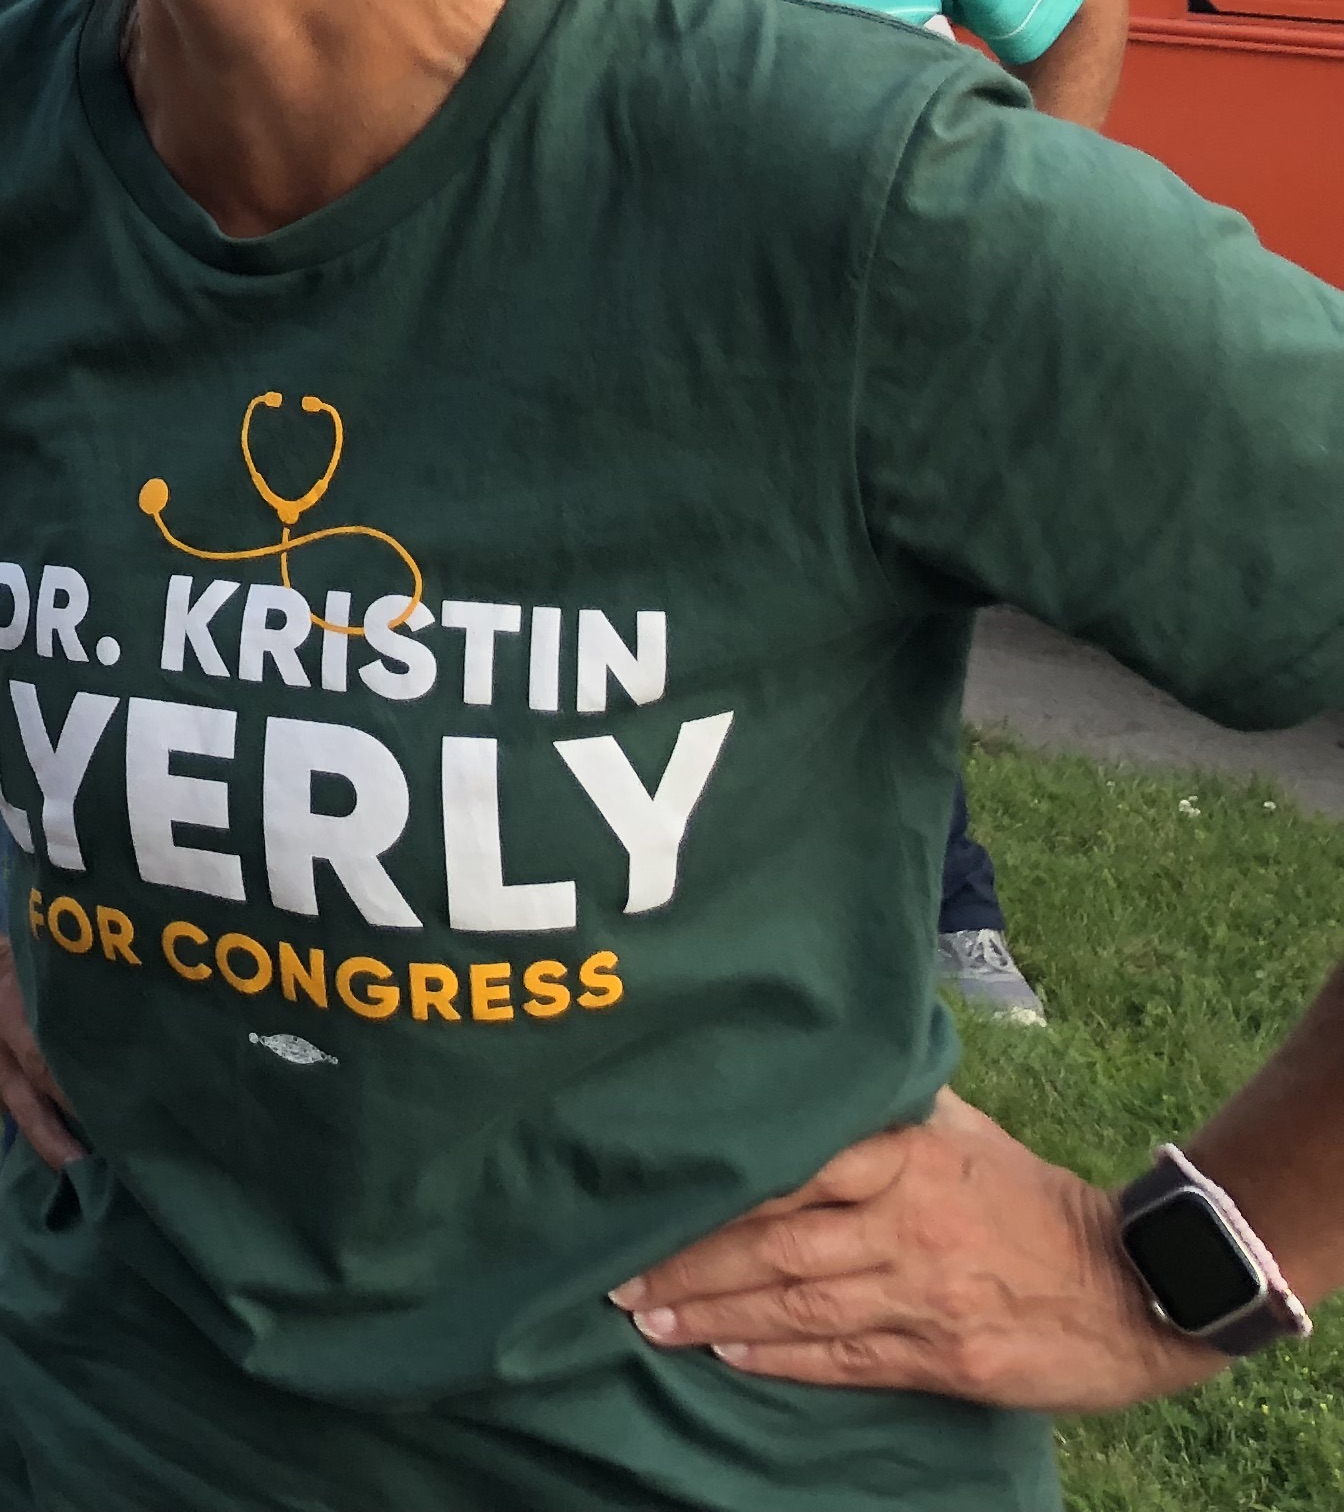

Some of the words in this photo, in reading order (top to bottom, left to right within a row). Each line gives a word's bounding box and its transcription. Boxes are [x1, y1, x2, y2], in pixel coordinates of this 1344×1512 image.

[161, 574, 667, 713] KRISTIN
[29, 887, 142, 966] FOR
[161, 921, 625, 1022] CONGRESS
